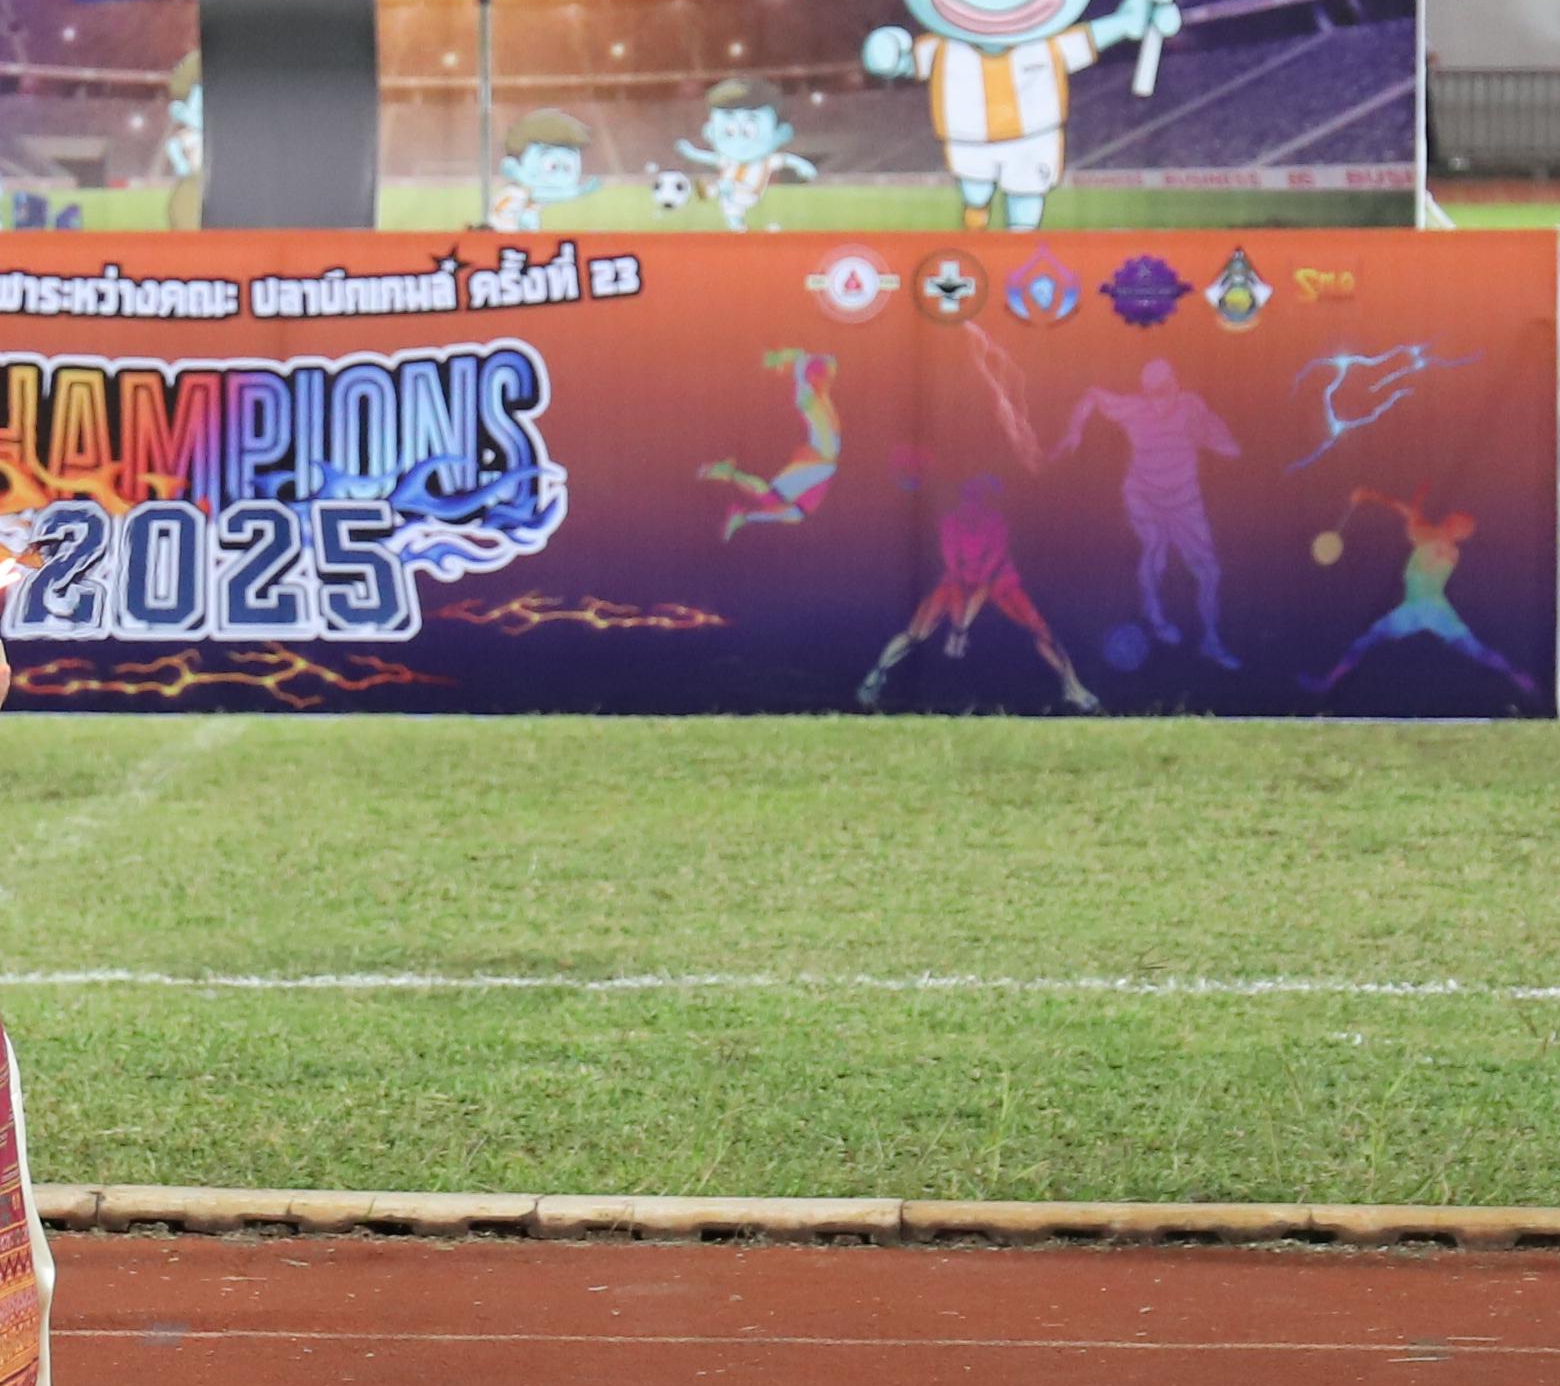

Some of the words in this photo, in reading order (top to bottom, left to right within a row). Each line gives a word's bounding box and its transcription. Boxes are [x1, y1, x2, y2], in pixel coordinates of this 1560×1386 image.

[467, 239, 580, 311] ครั้งที่
[587, 255, 642, 300] 23
[12, 501, 418, 637] 2025
